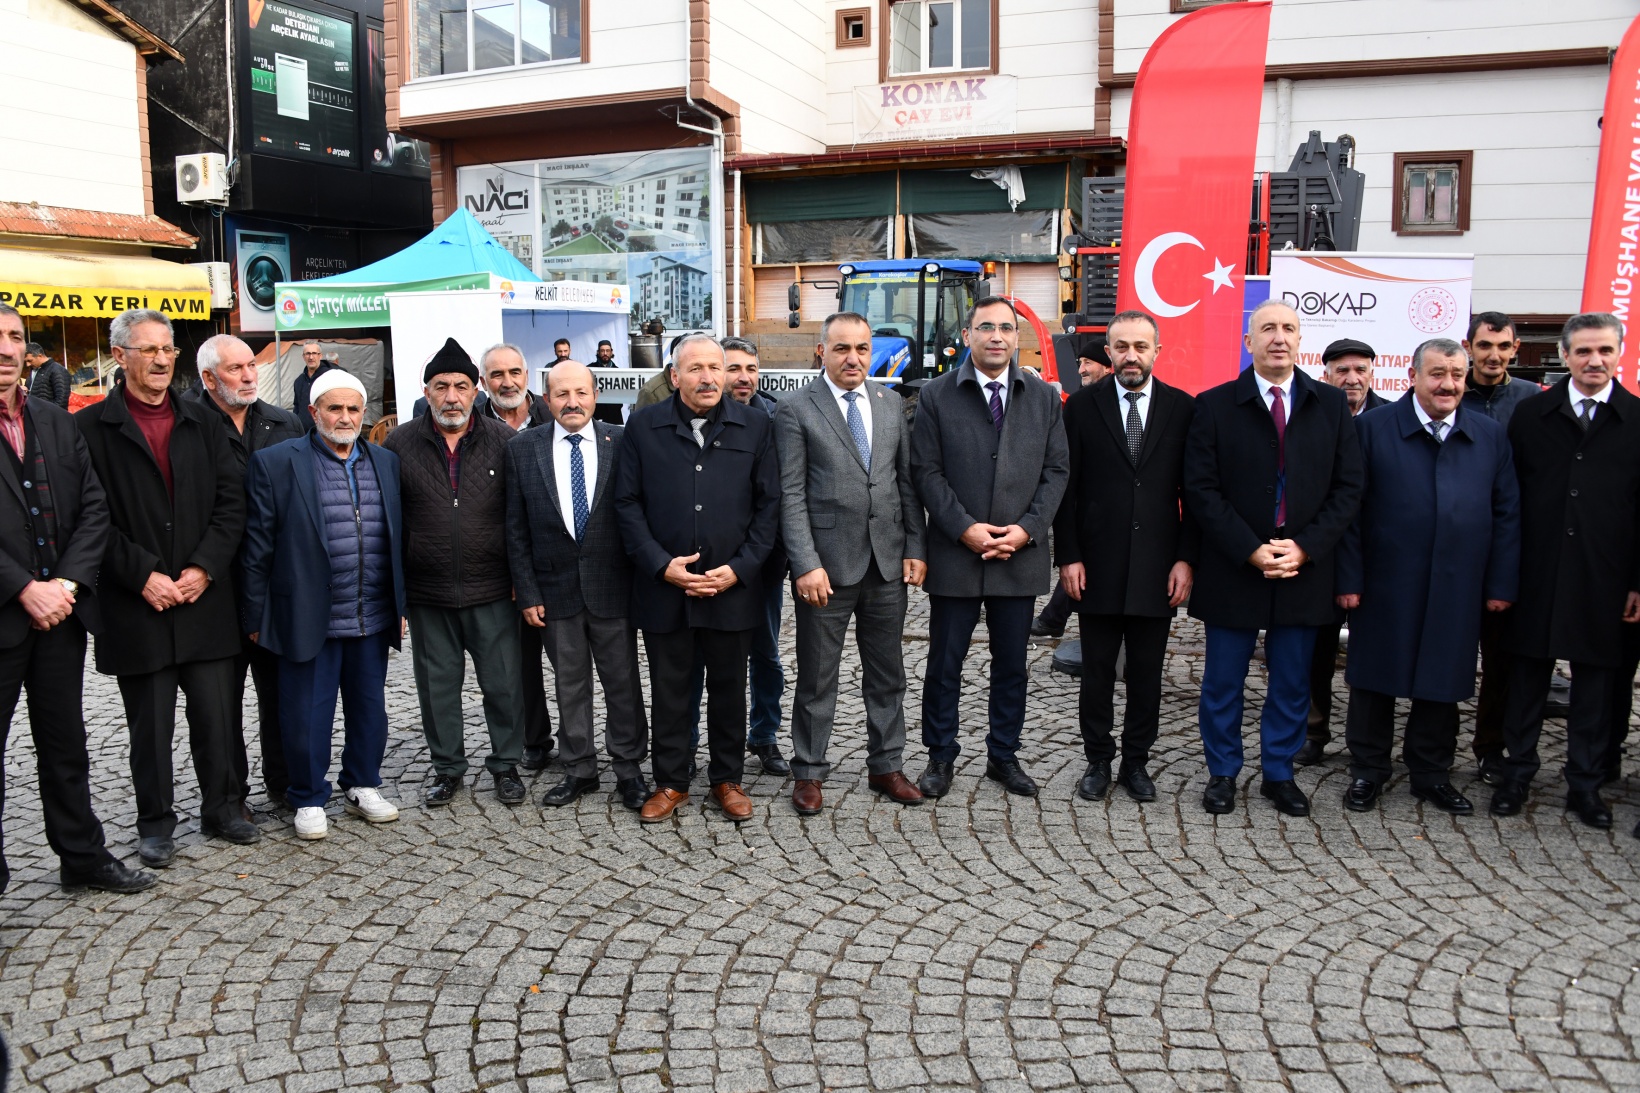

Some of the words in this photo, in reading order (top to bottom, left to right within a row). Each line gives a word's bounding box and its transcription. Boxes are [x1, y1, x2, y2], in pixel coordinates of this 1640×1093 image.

[273, 6, 288, 15] KADAR
[284, 17, 320, 34] DETERJANI
[300, 32, 335, 48] AYARLASIN
[880, 78, 987, 107] KONAK
[894, 109, 933, 127] ÇAY
[940, 103, 972, 122] EVİ
[305, 258, 347, 269] ARÇELİK'TEN
[0, 291, 83, 310] PAZAR
[93, 294, 148, 312] YERİ
[160, 298, 205, 313] AVM
[535, 284, 558, 301] KELKİT
[561, 286, 596, 303] BELEDİYESİ
[307, 294, 345, 319] ÇİFTÇİ
[1282, 291, 1377, 316] DOKAP
[1294, 353, 1322, 365] AYVA
[1371, 354, 1414, 368] LTYAP
